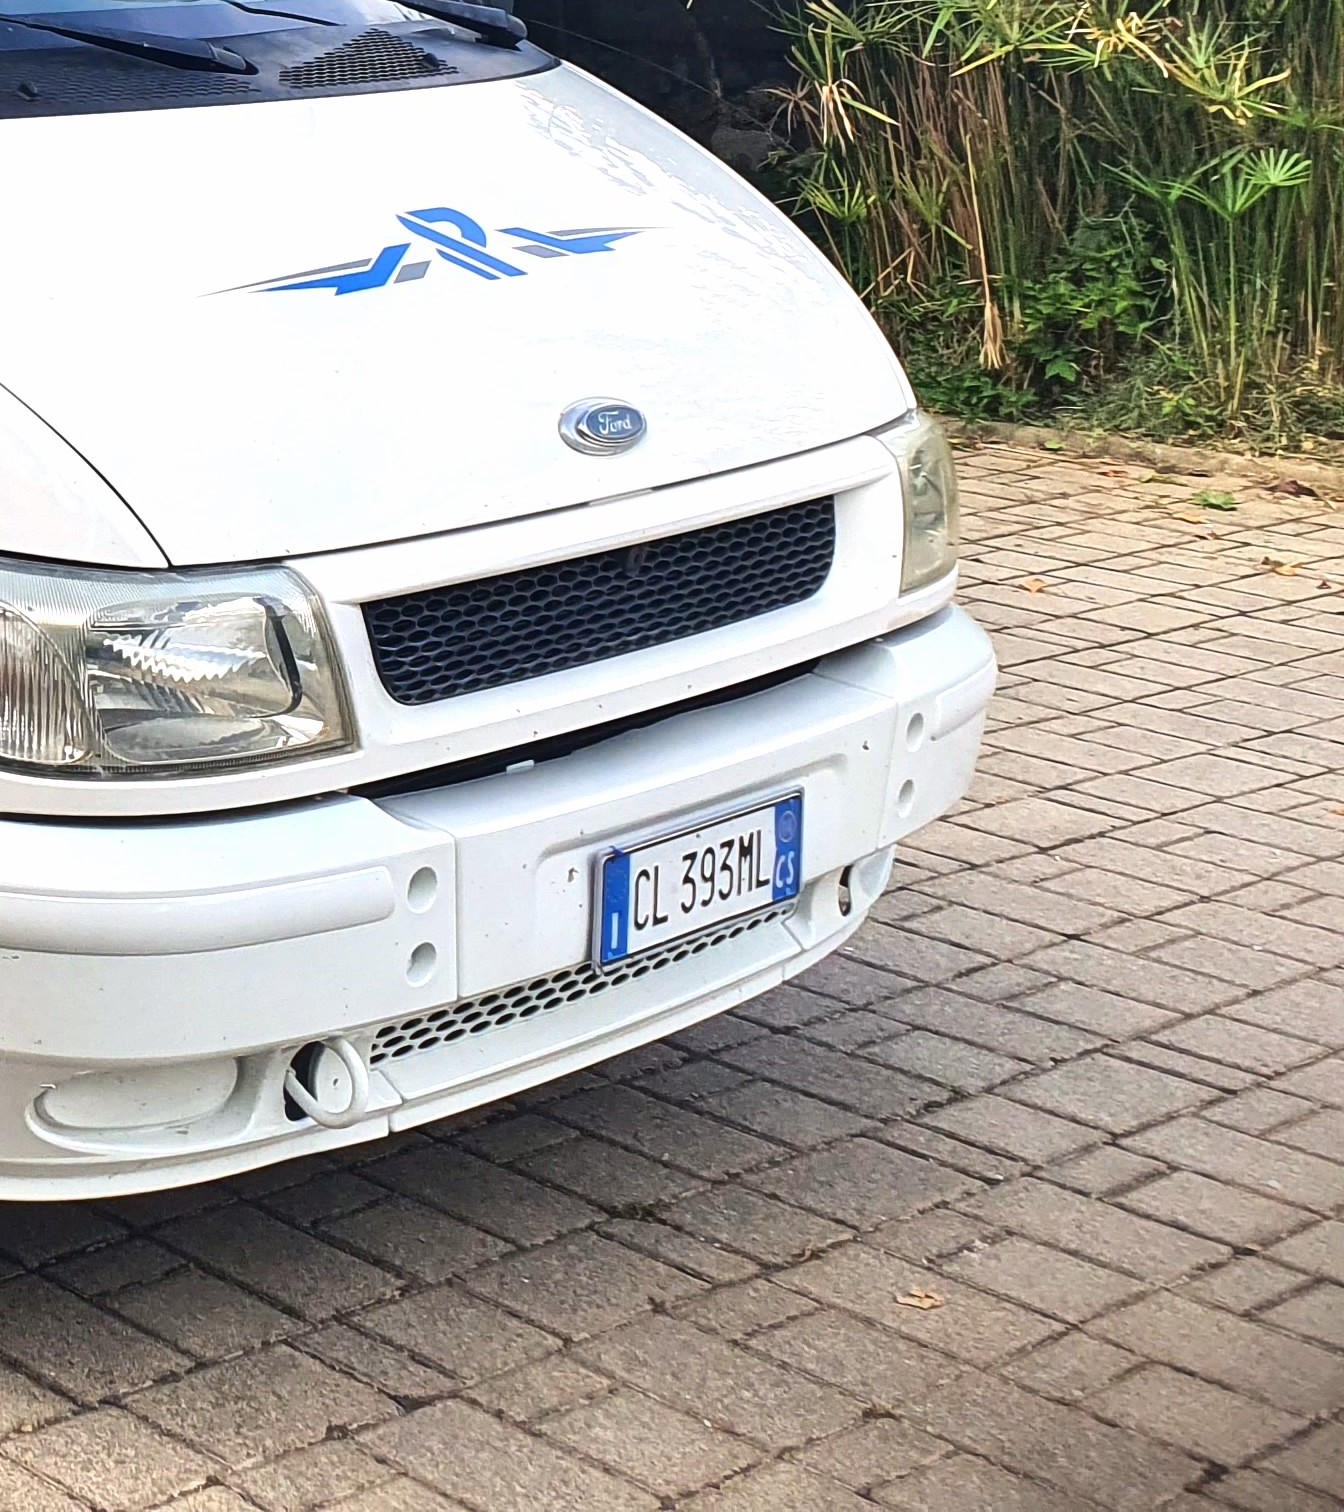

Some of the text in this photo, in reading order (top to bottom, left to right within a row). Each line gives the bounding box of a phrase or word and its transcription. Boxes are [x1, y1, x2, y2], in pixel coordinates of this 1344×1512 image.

[598, 410, 633, 435] Ford
[775, 851, 795, 888] CS
[633, 865, 668, 930] CL
